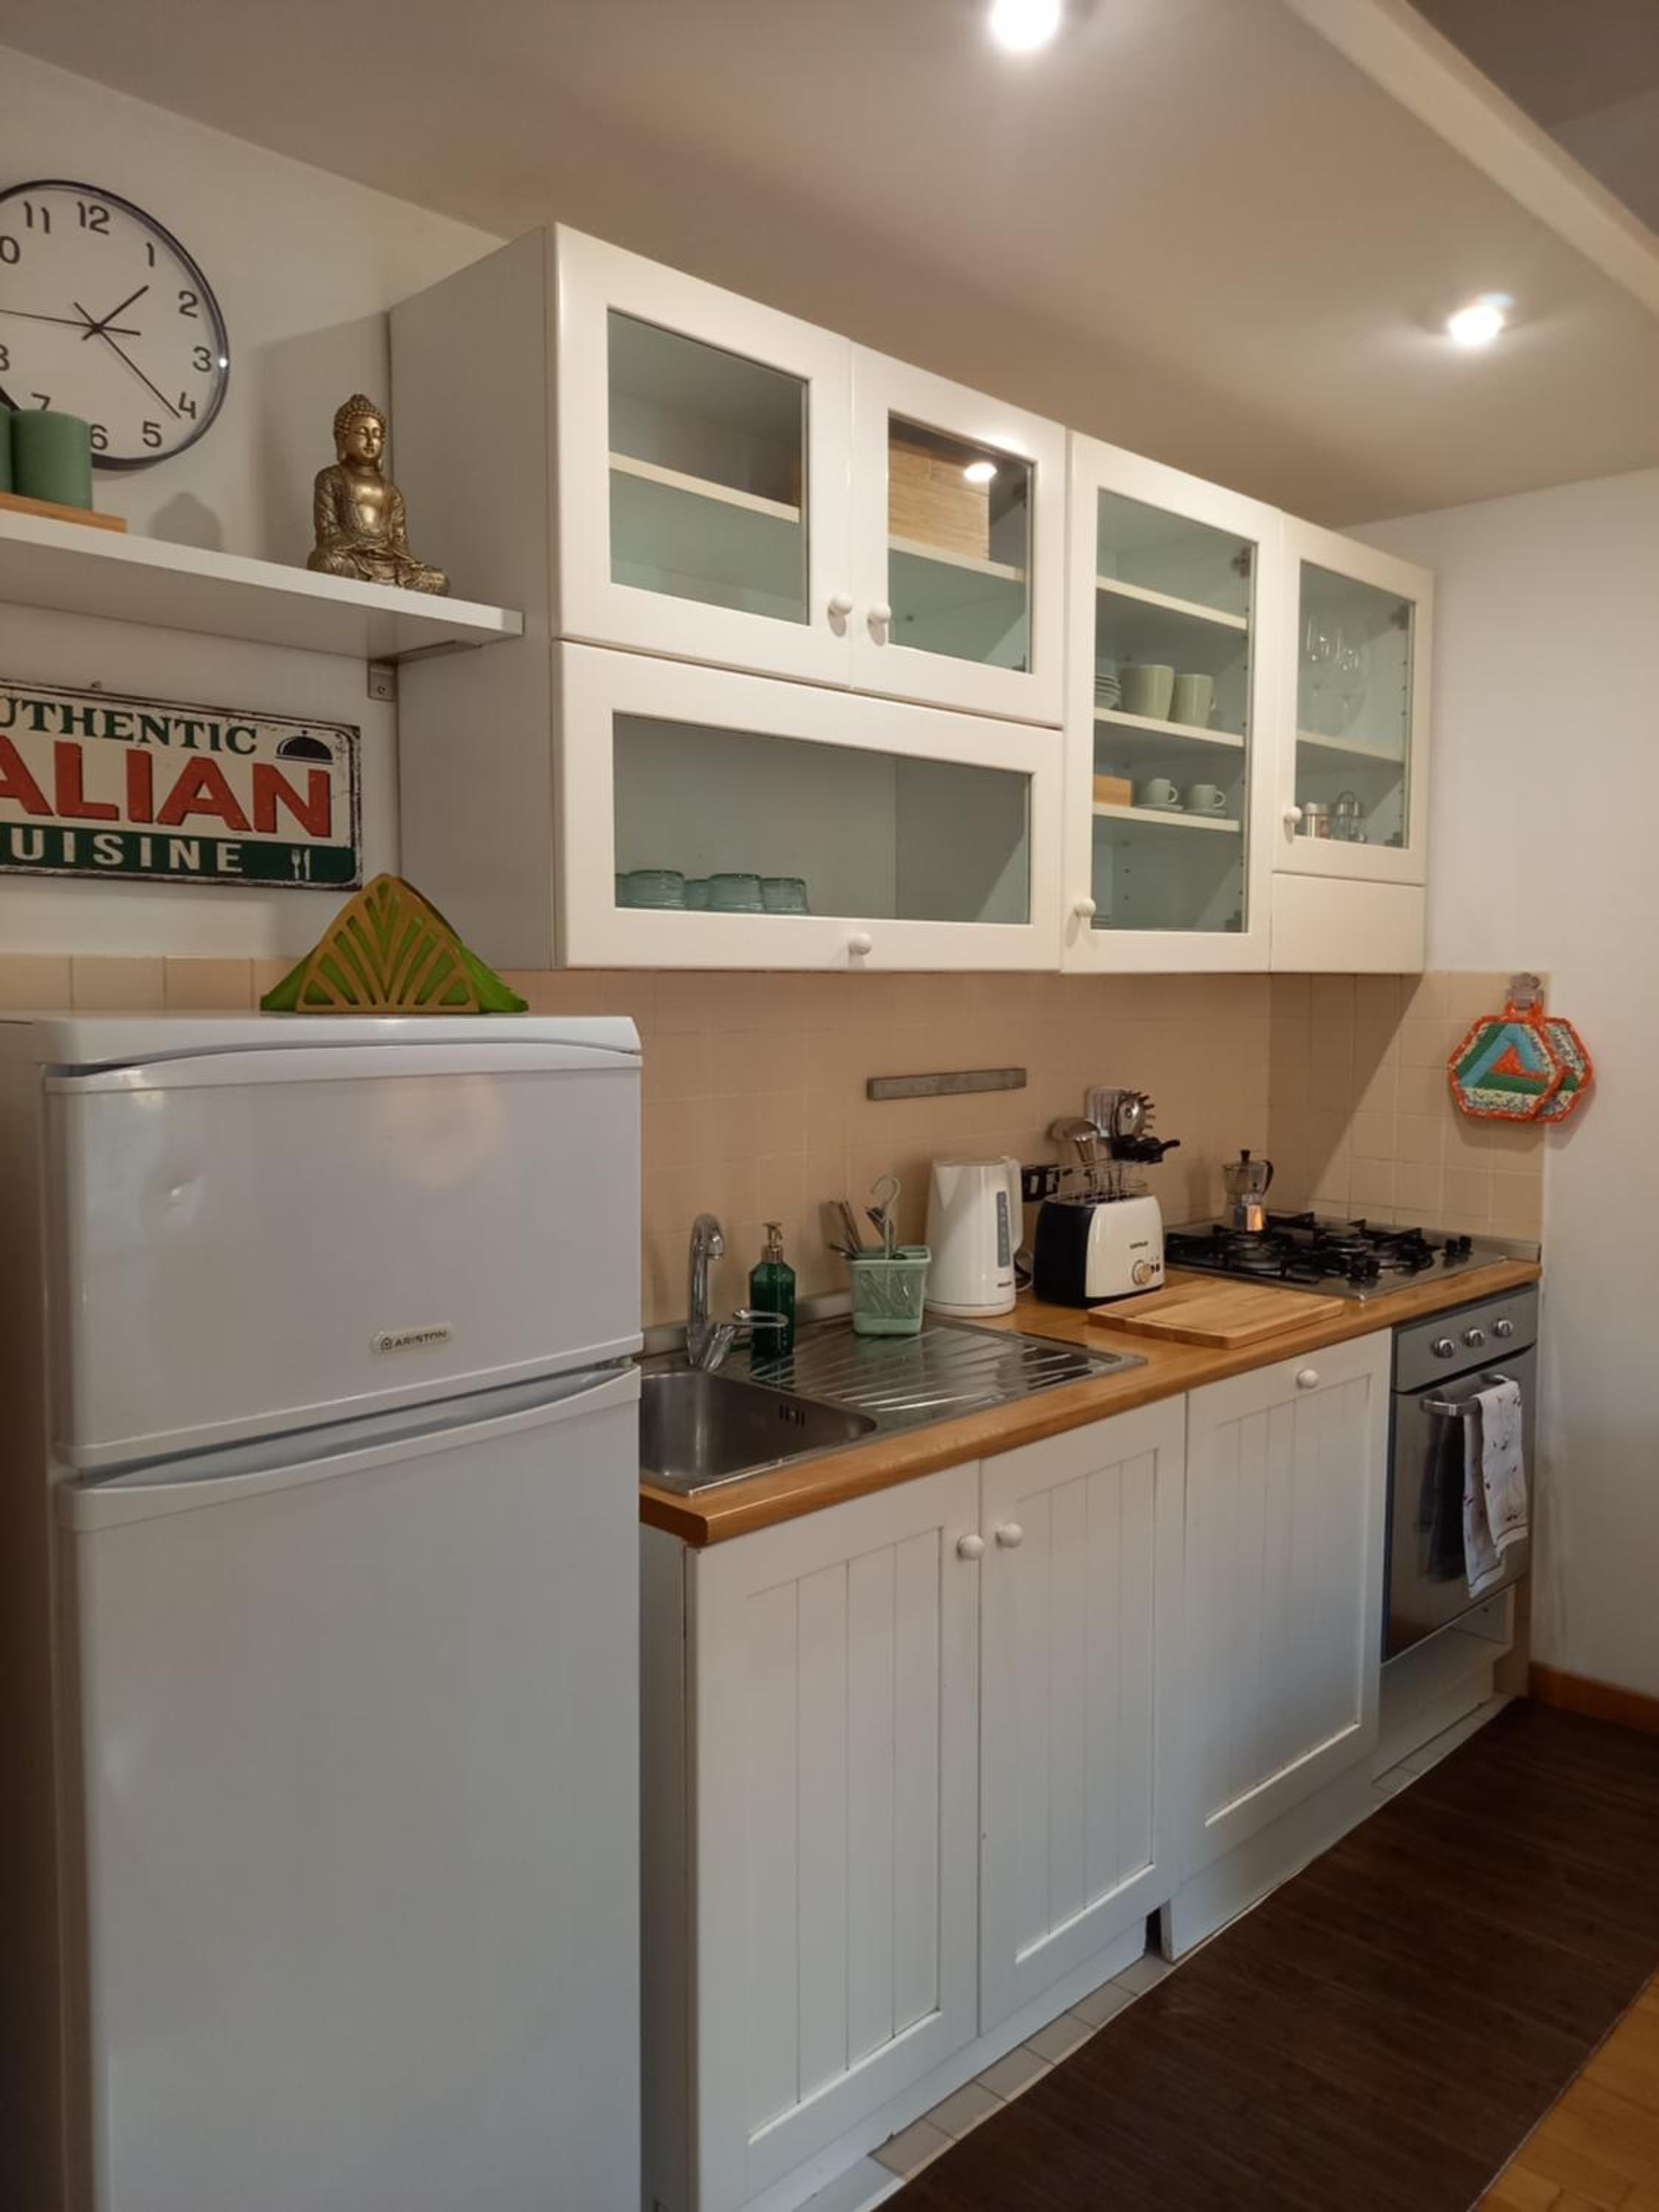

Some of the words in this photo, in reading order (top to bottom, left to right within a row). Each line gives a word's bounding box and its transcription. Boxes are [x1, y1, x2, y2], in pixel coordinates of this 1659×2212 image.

[24, 201, 50, 234] 11
[77, 201, 110, 235] 12
[146, 242, 155, 267] 1
[178, 291, 198, 318] 2
[192, 346, 212, 372] 3
[178, 392, 197, 420] 4
[90, 424, 108, 451] 6
[142, 421, 162, 448] 5
[11, 827, 243, 873] UISINE
